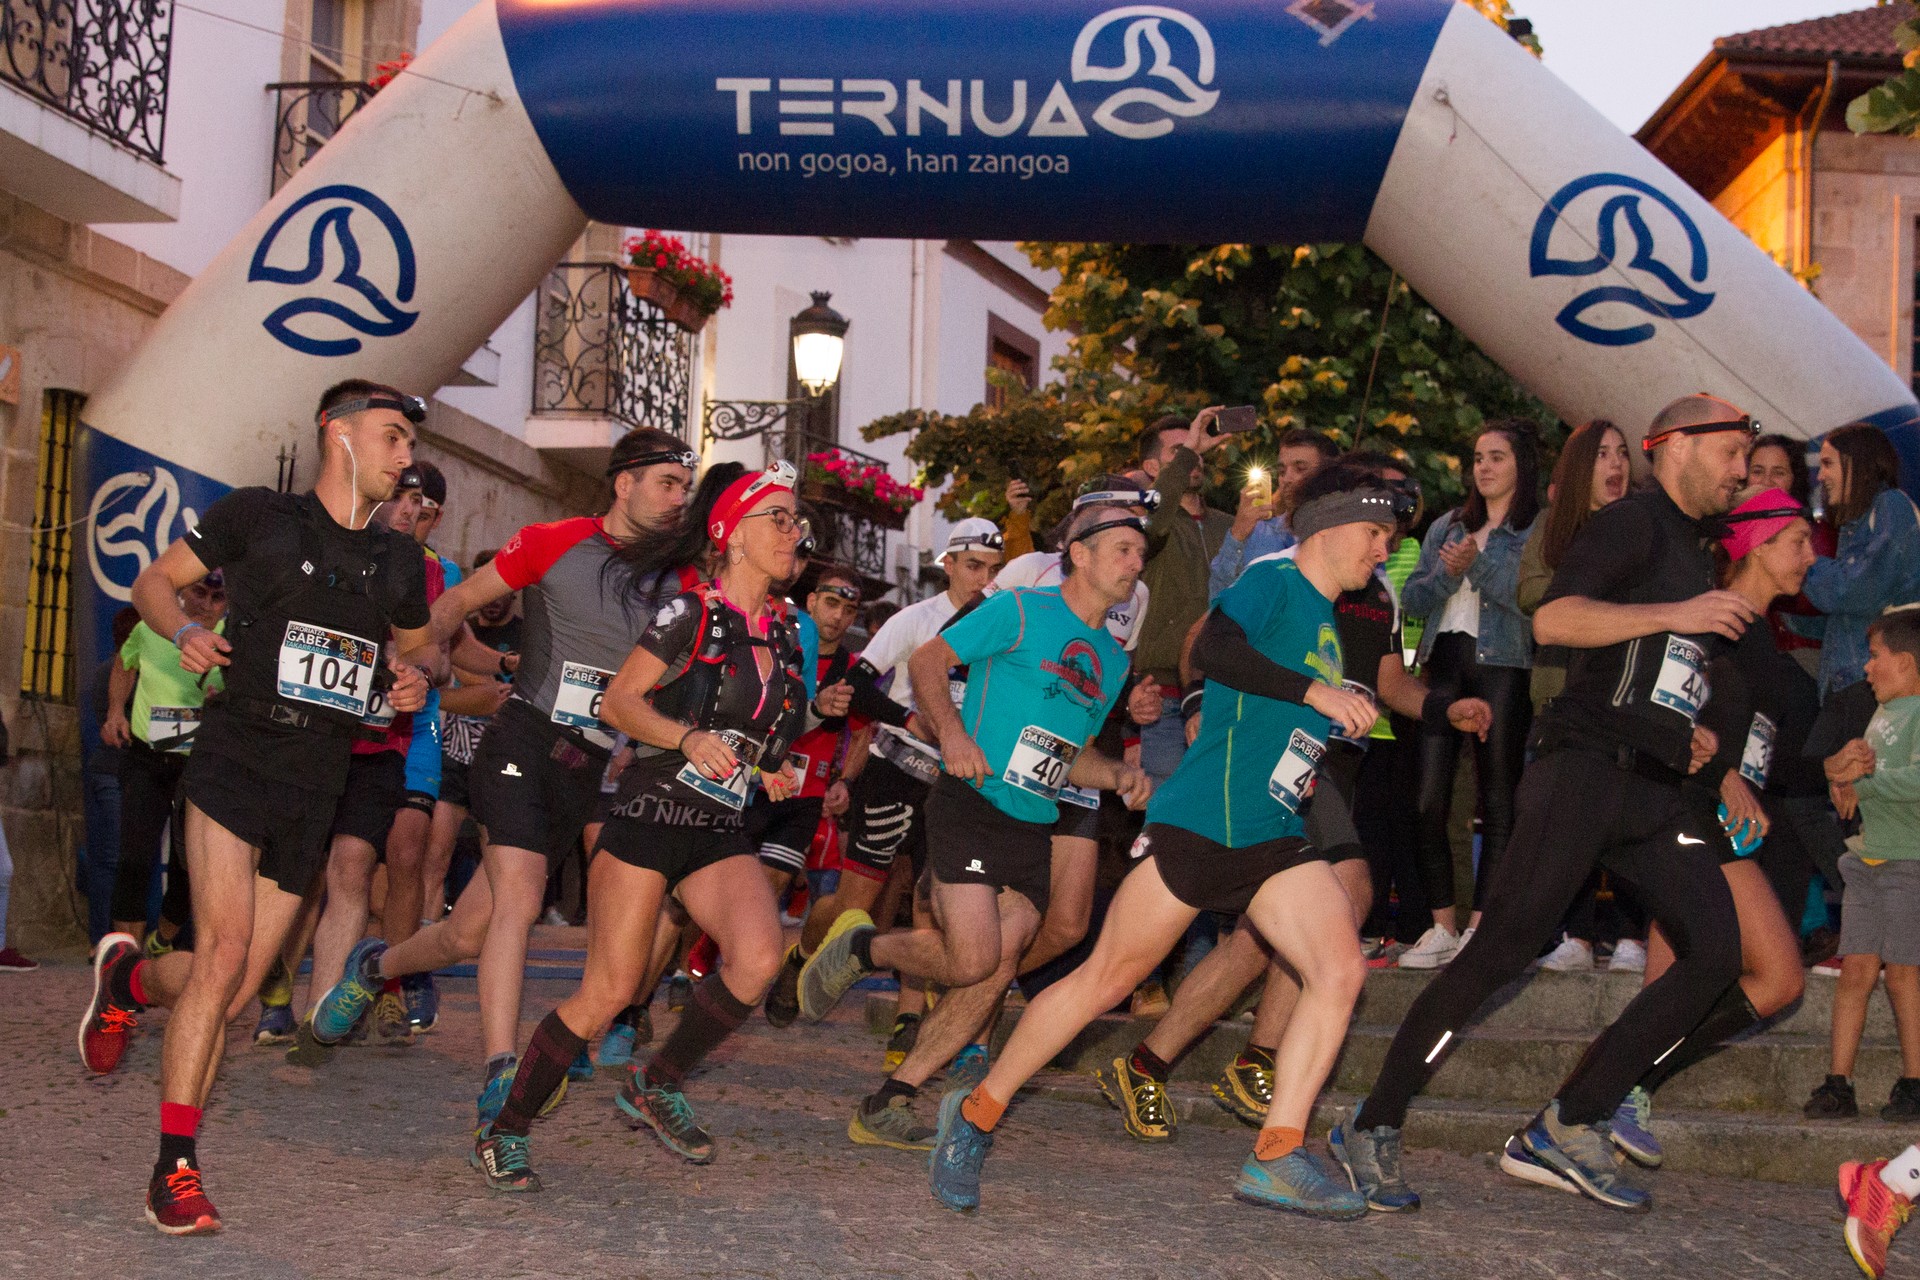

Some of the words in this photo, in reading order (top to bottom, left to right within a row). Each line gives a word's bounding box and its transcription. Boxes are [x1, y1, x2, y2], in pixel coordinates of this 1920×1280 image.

[716, 77, 1089, 137] TERNUA
[738, 152, 790, 172] non
[800, 152, 896, 178] gogoa,
[907, 148, 957, 172] han
[969, 153, 1070, 179] zangoa
[287, 630, 331, 649] GABEZ
[289, 624, 326, 637] ESKORIATZA
[285, 640, 330, 656] TAKARRARAN
[361, 650, 374, 665] 15
[1669, 644, 1700, 664] GABEZ
[299, 652, 359, 696] 104
[565, 669, 602, 686] GABEZ
[589, 692, 605, 718] 6
[1023, 731, 1057, 752] GABEZ
[1292, 736, 1322, 763] GABEZ
[1032, 757, 1064, 787] 40
[1293, 768, 1313, 798] 4
[653, 799, 712, 827] NIKE
